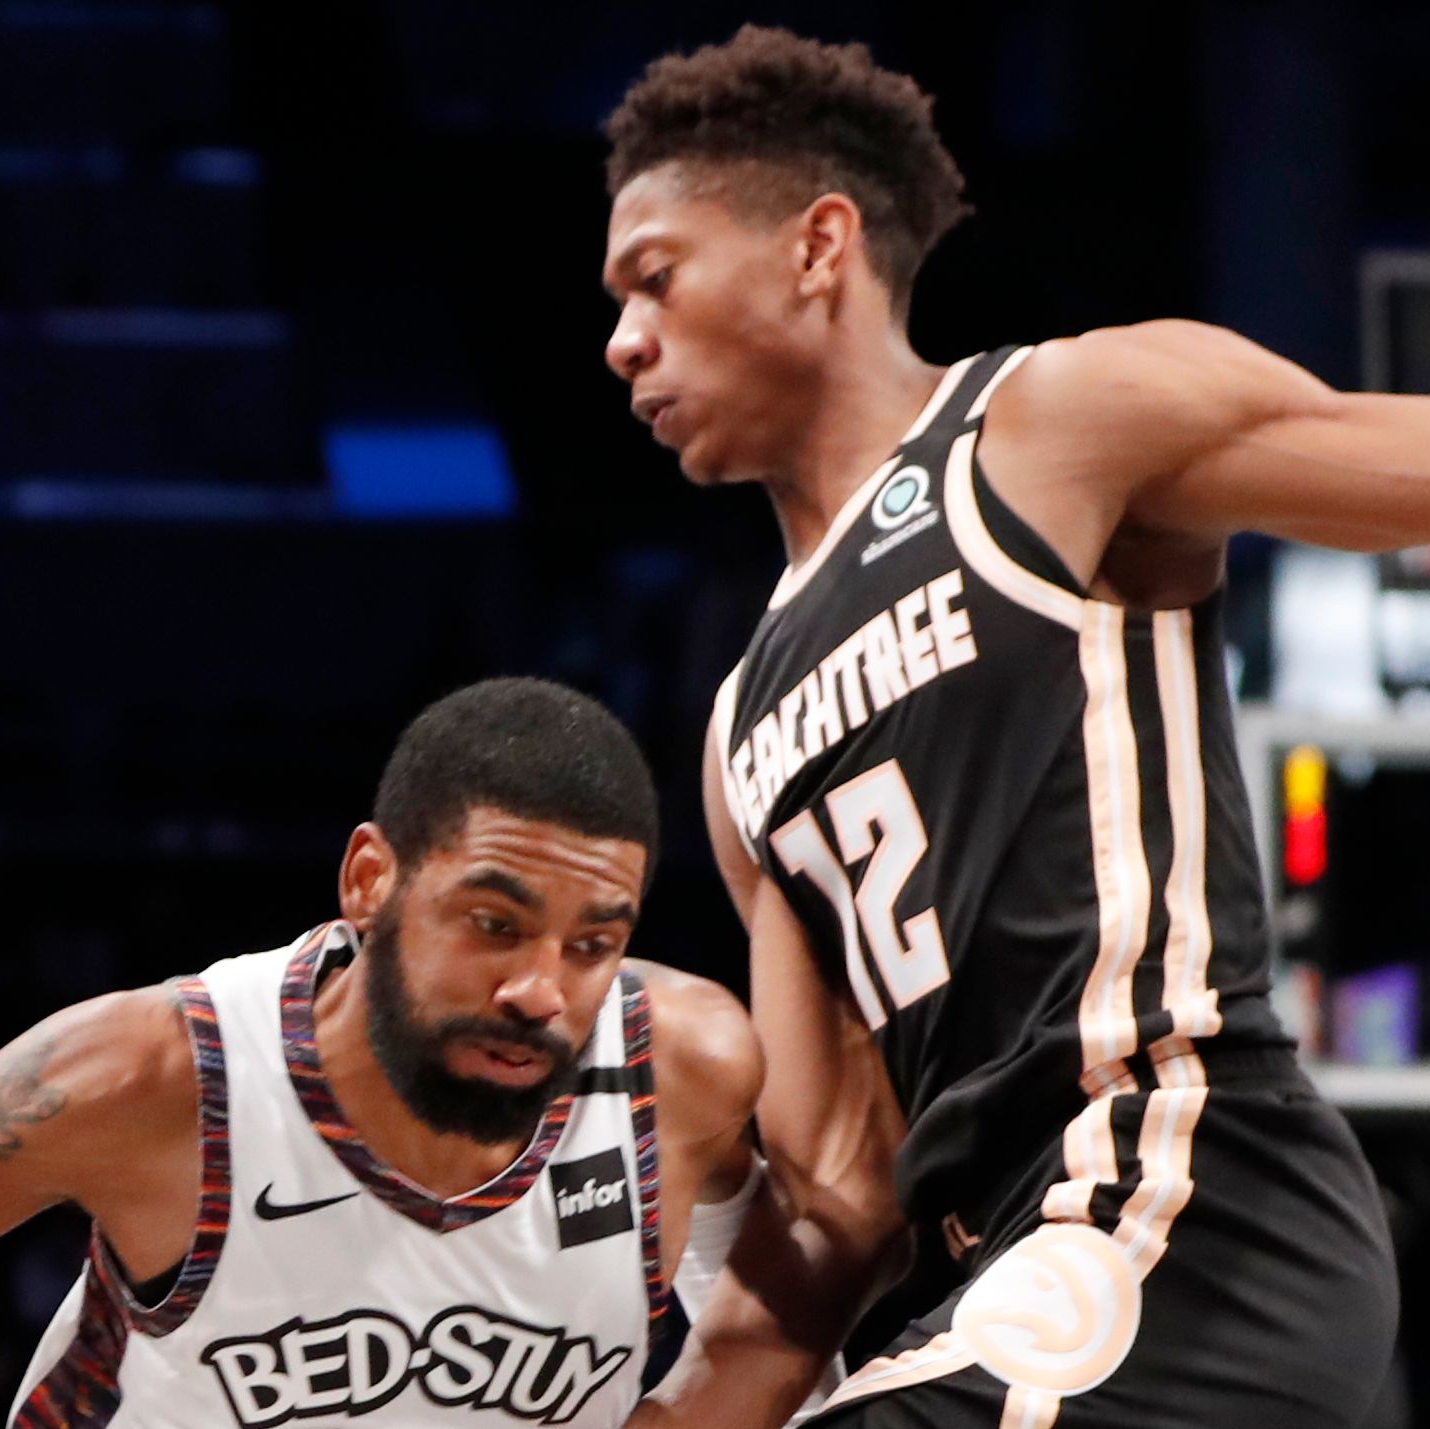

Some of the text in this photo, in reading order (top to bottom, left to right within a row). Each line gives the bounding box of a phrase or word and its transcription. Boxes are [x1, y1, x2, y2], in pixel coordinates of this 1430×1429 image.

[726, 568, 978, 842] EACHTREE
[769, 757, 951, 1031] 12
[556, 1177, 626, 1219] infor
